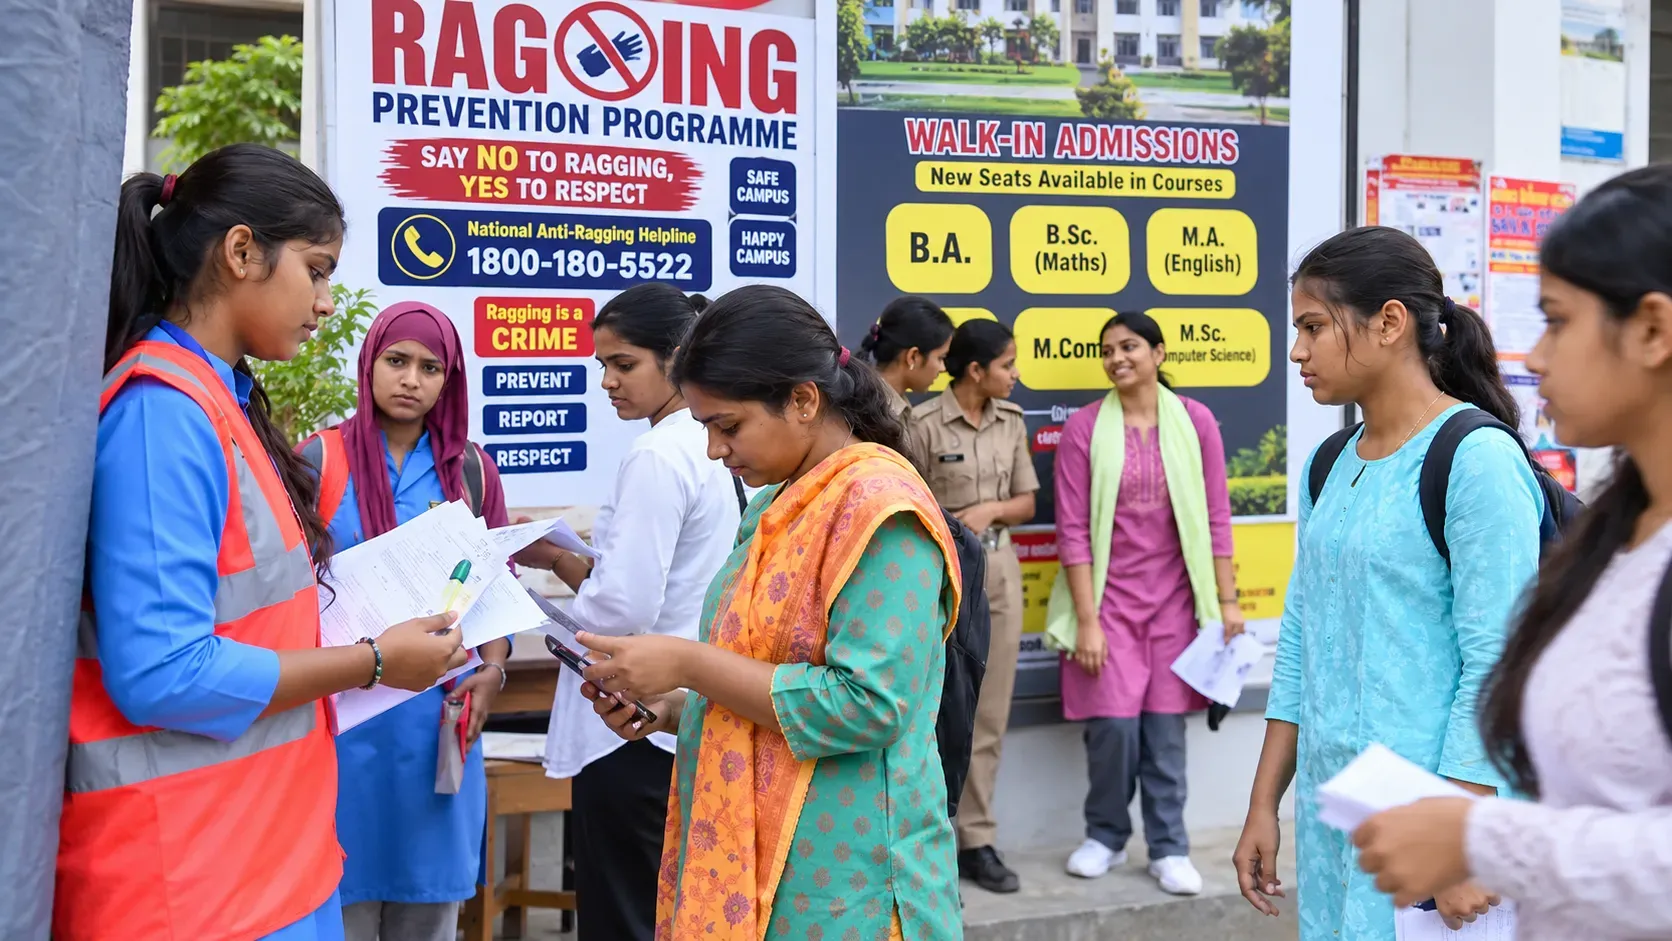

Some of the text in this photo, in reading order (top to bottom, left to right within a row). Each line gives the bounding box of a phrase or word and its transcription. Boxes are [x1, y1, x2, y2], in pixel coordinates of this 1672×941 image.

[373, 91, 797, 150] PREVENTION PROGRAMME
[905, 118, 1239, 163] WALK-IN ADMISSIONS
[421, 145, 674, 182] SAY NO TO RAGGING,
[747, 170, 779, 185] SAFE
[931, 167, 1223, 192] New Seats Available in Courses
[460, 175, 648, 204] YES TO RESPECT
[736, 187, 789, 204] CAMPUS
[468, 221, 696, 245] National Anti-Ragging Helpline
[742, 231, 785, 247] HAPPY
[1047, 224, 1097, 245] B.Sc.
[1183, 227, 1224, 247] M.A.
[736, 249, 790, 265] CAMPUS
[910, 232, 971, 264] B.A.
[467, 247, 693, 279] 1800-180-5522
[1035, 251, 1107, 275] (Maths)
[1164, 254, 1241, 277] (English)
[486, 304, 582, 323] Ragging is a
[492, 327, 577, 350] CRIME
[1180, 325, 1226, 342] M.Sc.
[1210, 349, 1256, 363] Science)
[496, 372, 571, 388] PREVENT
[499, 410, 568, 427] REPORT
[497, 448, 571, 466] RESPECT
